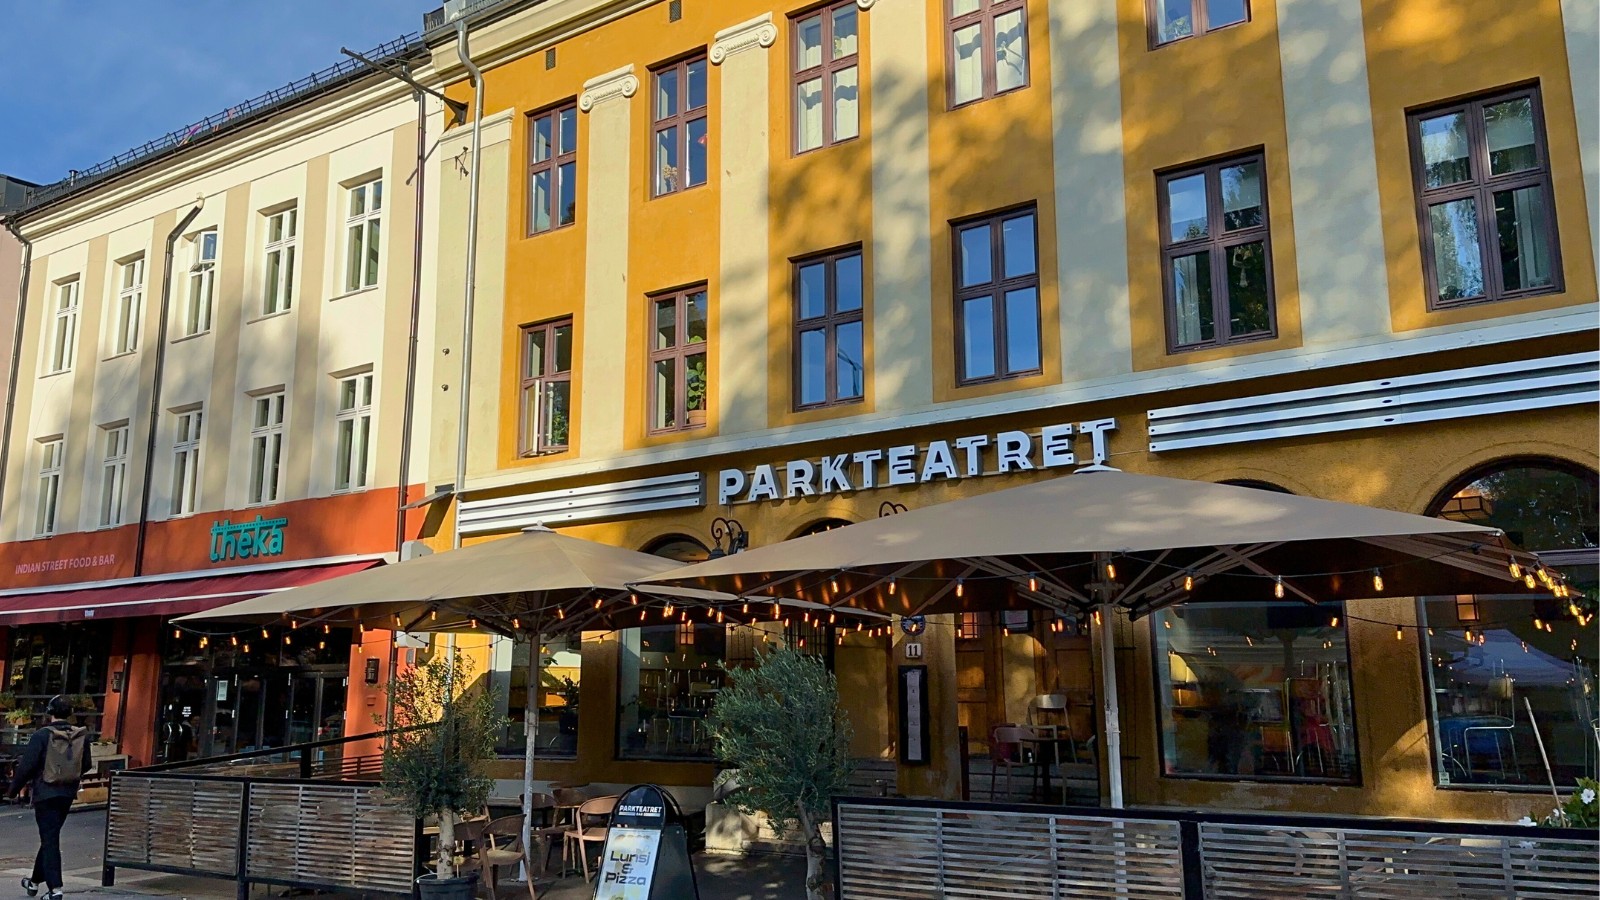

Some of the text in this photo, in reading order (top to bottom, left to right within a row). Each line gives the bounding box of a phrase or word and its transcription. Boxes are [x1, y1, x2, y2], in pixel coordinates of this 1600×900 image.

[719, 417, 1118, 505] PARKTEATRET
[210, 515, 287, 562] theka
[15, 554, 115, 575] INDIAN STREET FOOD & BAR
[908, 645, 918, 656] 11
[610, 851, 650, 865] Lunsj
[621, 863, 633, 874] &
[605, 872, 646, 885] Pizza
